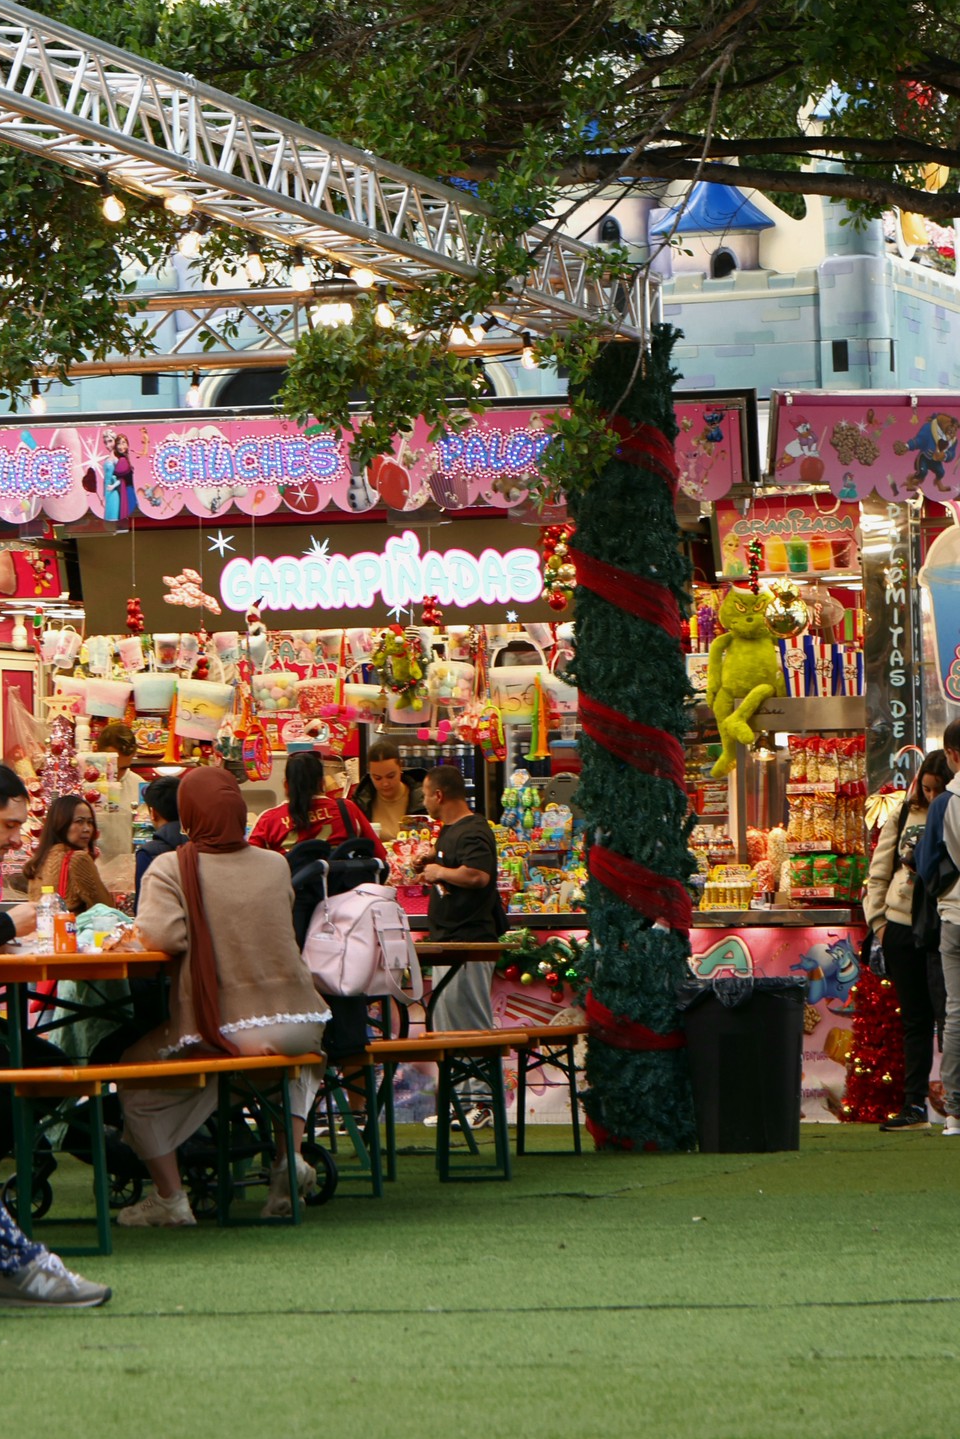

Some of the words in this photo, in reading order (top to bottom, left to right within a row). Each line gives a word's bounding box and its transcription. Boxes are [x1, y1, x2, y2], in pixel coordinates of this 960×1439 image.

[152, 434, 344, 488] CHUCHES
[436, 430, 553, 478] PALO
[733, 509, 854, 536] GRANIZADA
[223, 532, 540, 610] GARRAPIÑADAS
[280, 807, 333, 829] YBEL
